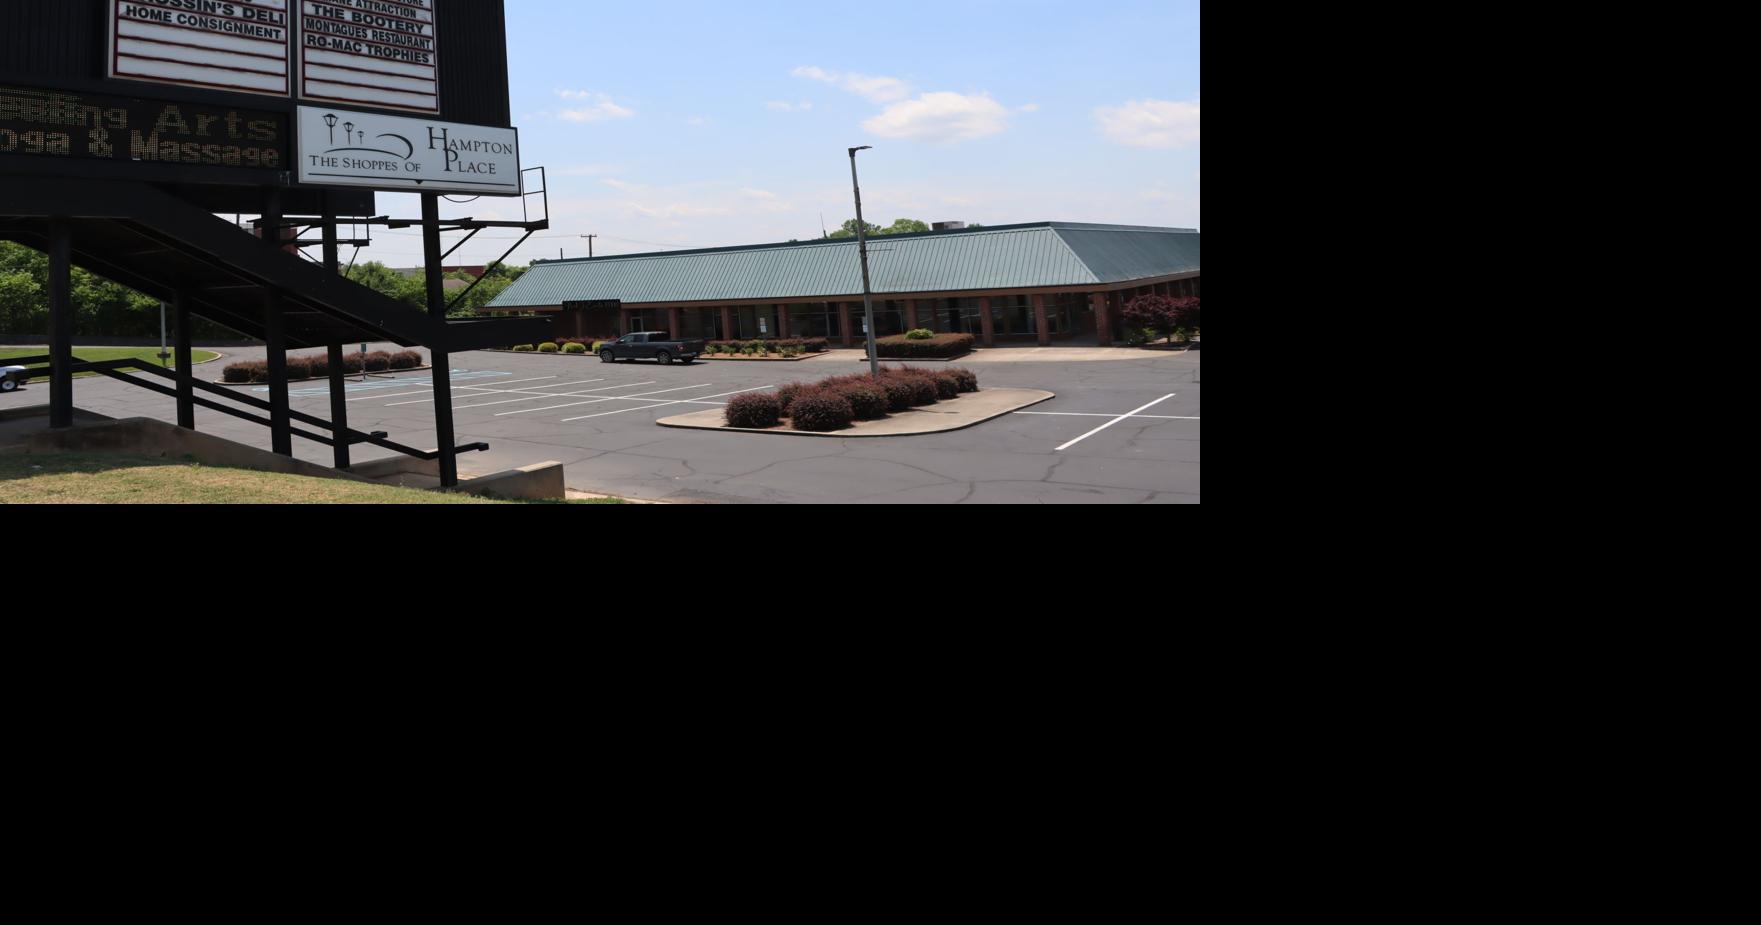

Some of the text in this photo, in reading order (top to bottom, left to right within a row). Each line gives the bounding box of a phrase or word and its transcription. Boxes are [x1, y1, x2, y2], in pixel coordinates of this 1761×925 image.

[126, 5, 281, 39] HOME CONSIGNMENT
[242, 7, 284, 25] DELI
[311, 3, 424, 34] THE BOOTERY
[356, 0, 416, 18] ATTRACTION
[305, 18, 431, 49] MONTAGUES RESTAURANT
[307, 34, 430, 63] RO-MAC TROPHIES
[154, 105, 277, 141] Arts
[88, 126, 113, 158] &
[130, 129, 280, 168] Massage
[426, 126, 513, 156] HAMPTON
[309, 155, 421, 173] THE SHOPPES OF
[444, 148, 497, 175] PLACE
